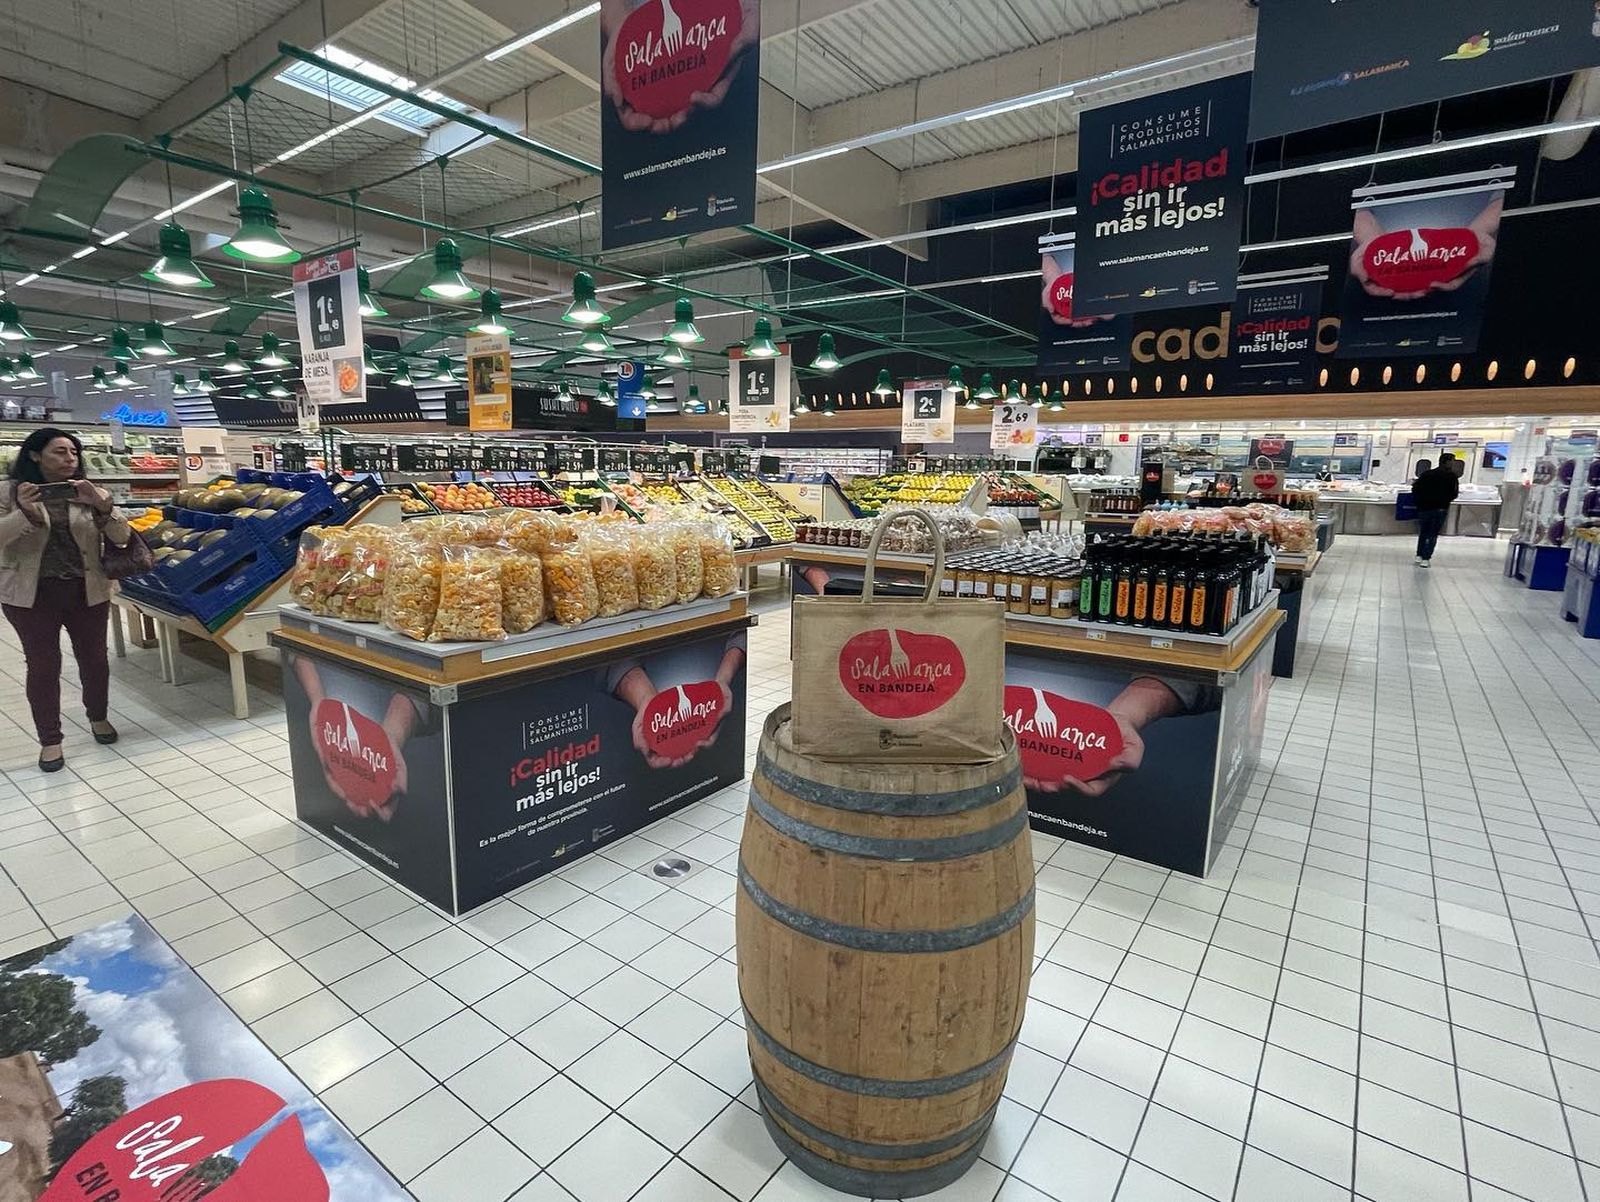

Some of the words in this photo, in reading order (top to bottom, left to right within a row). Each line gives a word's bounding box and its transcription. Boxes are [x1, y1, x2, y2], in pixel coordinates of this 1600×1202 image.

[625, 10, 726, 73] Salamanca
[632, 76, 647, 92] EN
[651, 56, 707, 83] BANDEJA
[1120, 106, 1201, 133] CONSUME
[1120, 116, 1201, 142] PRODUCTOS
[1119, 127, 1200, 153] SALMANTINOS
[623, 146, 727, 181] www.salamancaenbandeja.es
[1091, 148, 1229, 206] ¡Calidad
[1123, 188, 1160, 212] sin
[1167, 182, 1188, 204] ir
[1095, 213, 1147, 238] más
[1154, 196, 1225, 229] lejos!
[1099, 244, 1210, 268] www.salamancaenbandeja.es
[1238, 341, 1268, 354] más
[1270, 338, 1309, 353] lejos!
[1254, 331, 1275, 343] sin
[1278, 329, 1290, 341] ir
[851, 648, 952, 682] Salamanca
[858, 683, 875, 694] EN
[878, 682, 936, 694] BANDEJA
[529, 707, 583, 729] CONSUME
[529, 715, 584, 737] PRODUCTOS
[651, 696, 717, 733] Salamanca
[1003, 707, 1107, 750] alamanca
[529, 723, 584, 746] SALMANTINOS
[656, 730, 669, 744] EN
[670, 718, 708, 740] BANDEJA
[510, 734, 601, 787] ¡Calidad
[1019, 737, 1084, 763] BANDEJA
[515, 787, 555, 812] más
[557, 766, 602, 798] lejos!
[536, 767, 562, 789] sin
[566, 760, 579, 779] ir
[479, 839, 489, 848] Es
[490, 835, 497, 844] la
[497, 828, 518, 842] mejor
[518, 819, 538, 831] forma
[538, 815, 547, 823] de
[527, 828, 536, 836] de
[75, 1161, 113, 1196] EN
